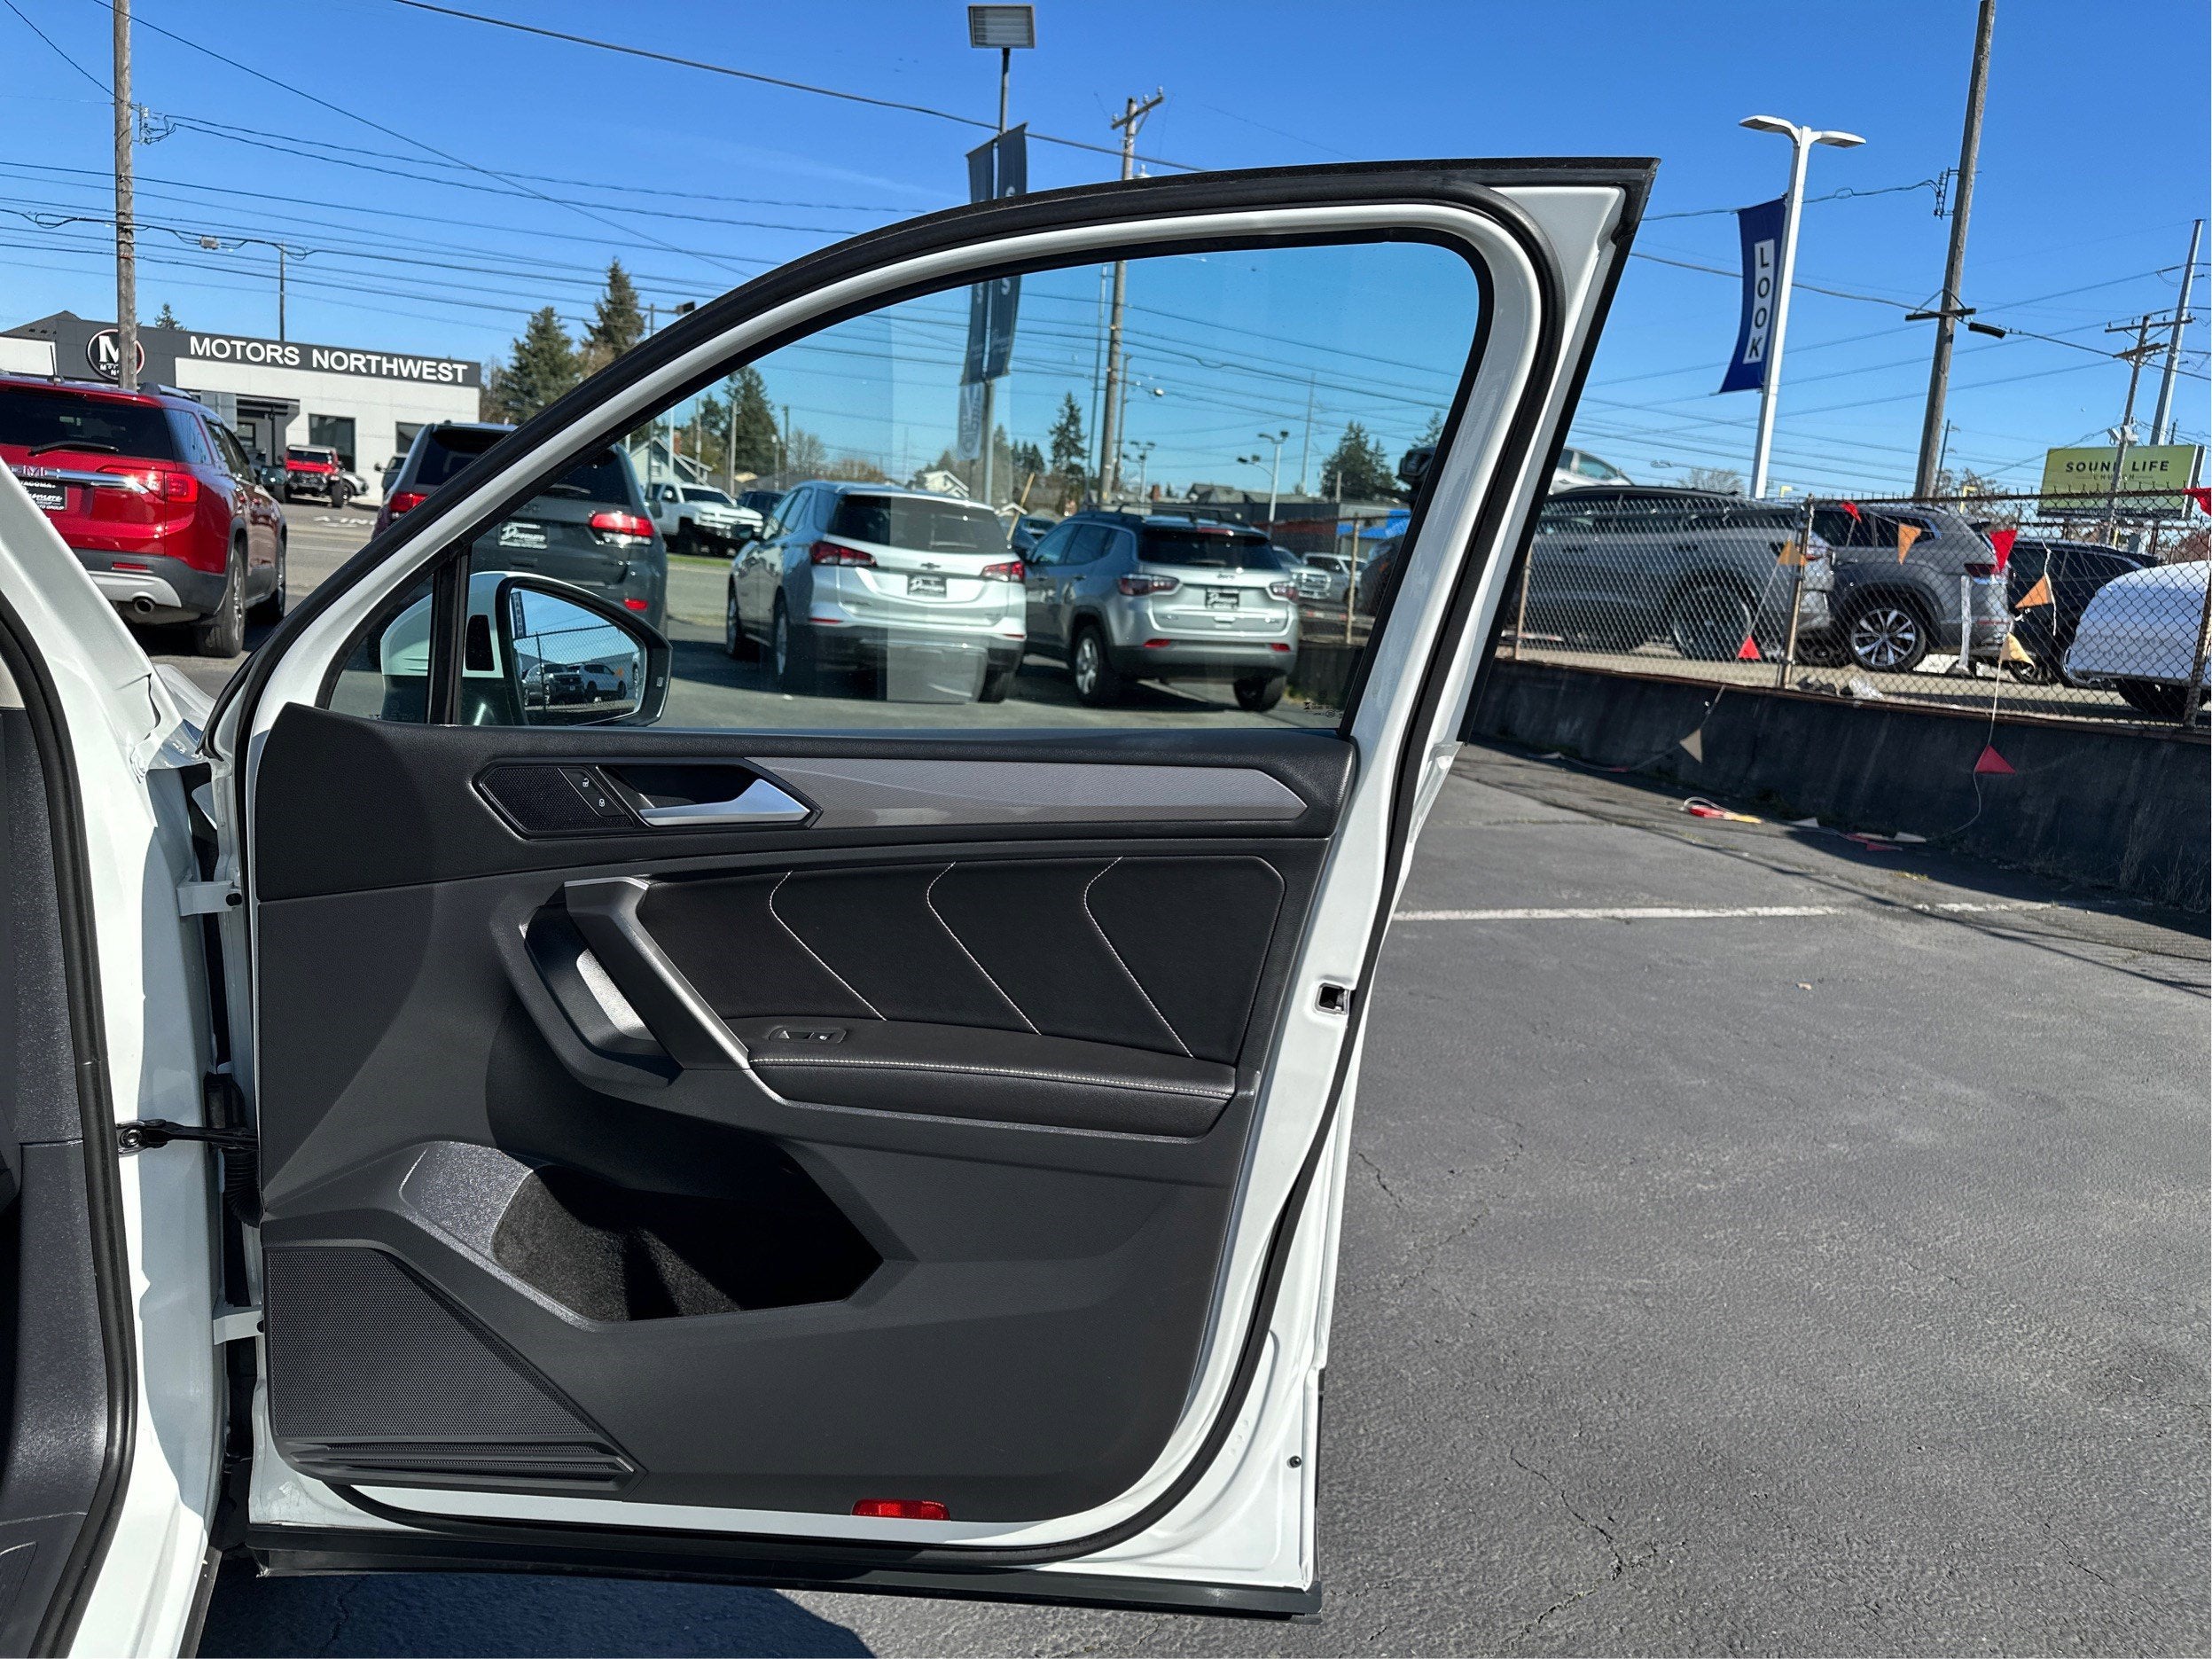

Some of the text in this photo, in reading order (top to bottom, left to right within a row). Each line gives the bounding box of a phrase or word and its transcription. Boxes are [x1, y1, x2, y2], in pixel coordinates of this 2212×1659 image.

[1748, 247, 1770, 358] LOOK
[189, 336, 468, 383] MOTORS NORTHWEST
[2065, 459, 2170, 473] SOUN LIFE
